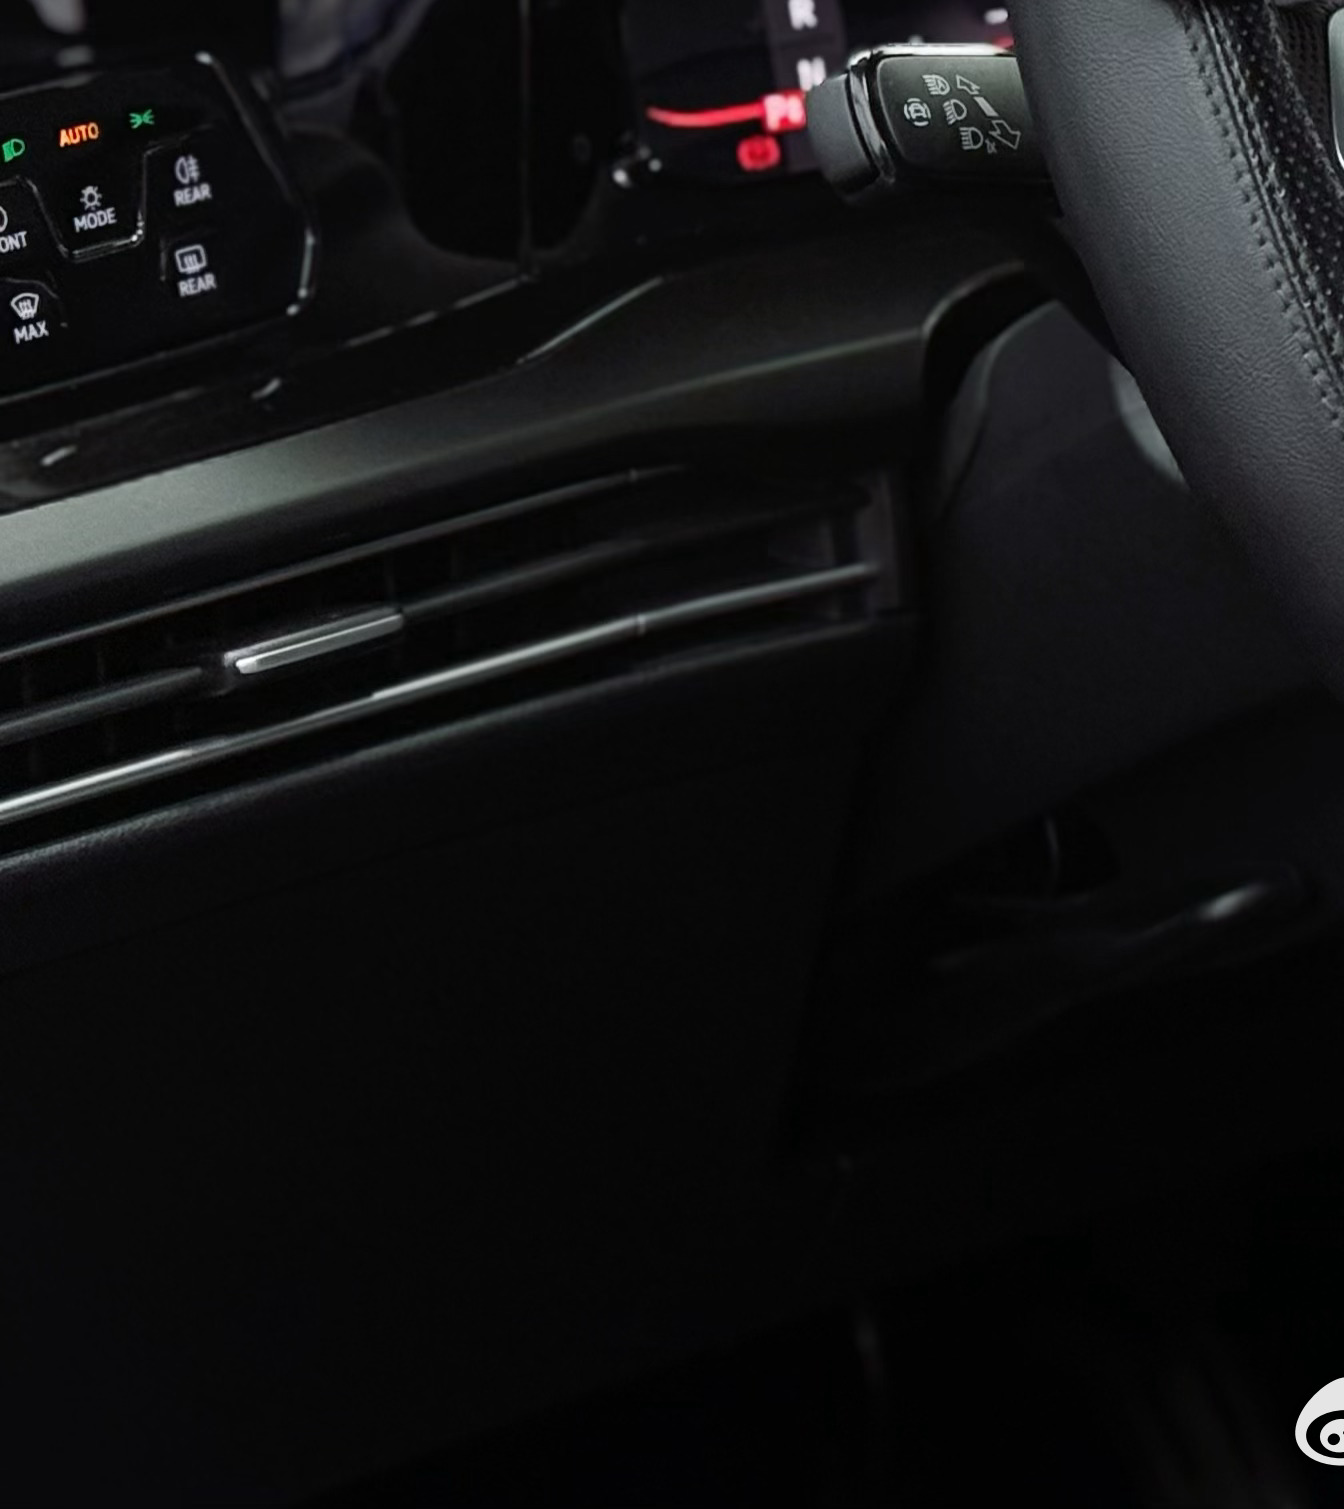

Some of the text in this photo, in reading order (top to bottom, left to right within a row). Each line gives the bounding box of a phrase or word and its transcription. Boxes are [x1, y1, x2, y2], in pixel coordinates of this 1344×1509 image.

[59, 122, 100, 148] AUTO
[174, 182, 213, 208] REAR
[73, 207, 117, 233] MODE
[178, 272, 217, 298] REAR
[13, 320, 50, 345] MAX
